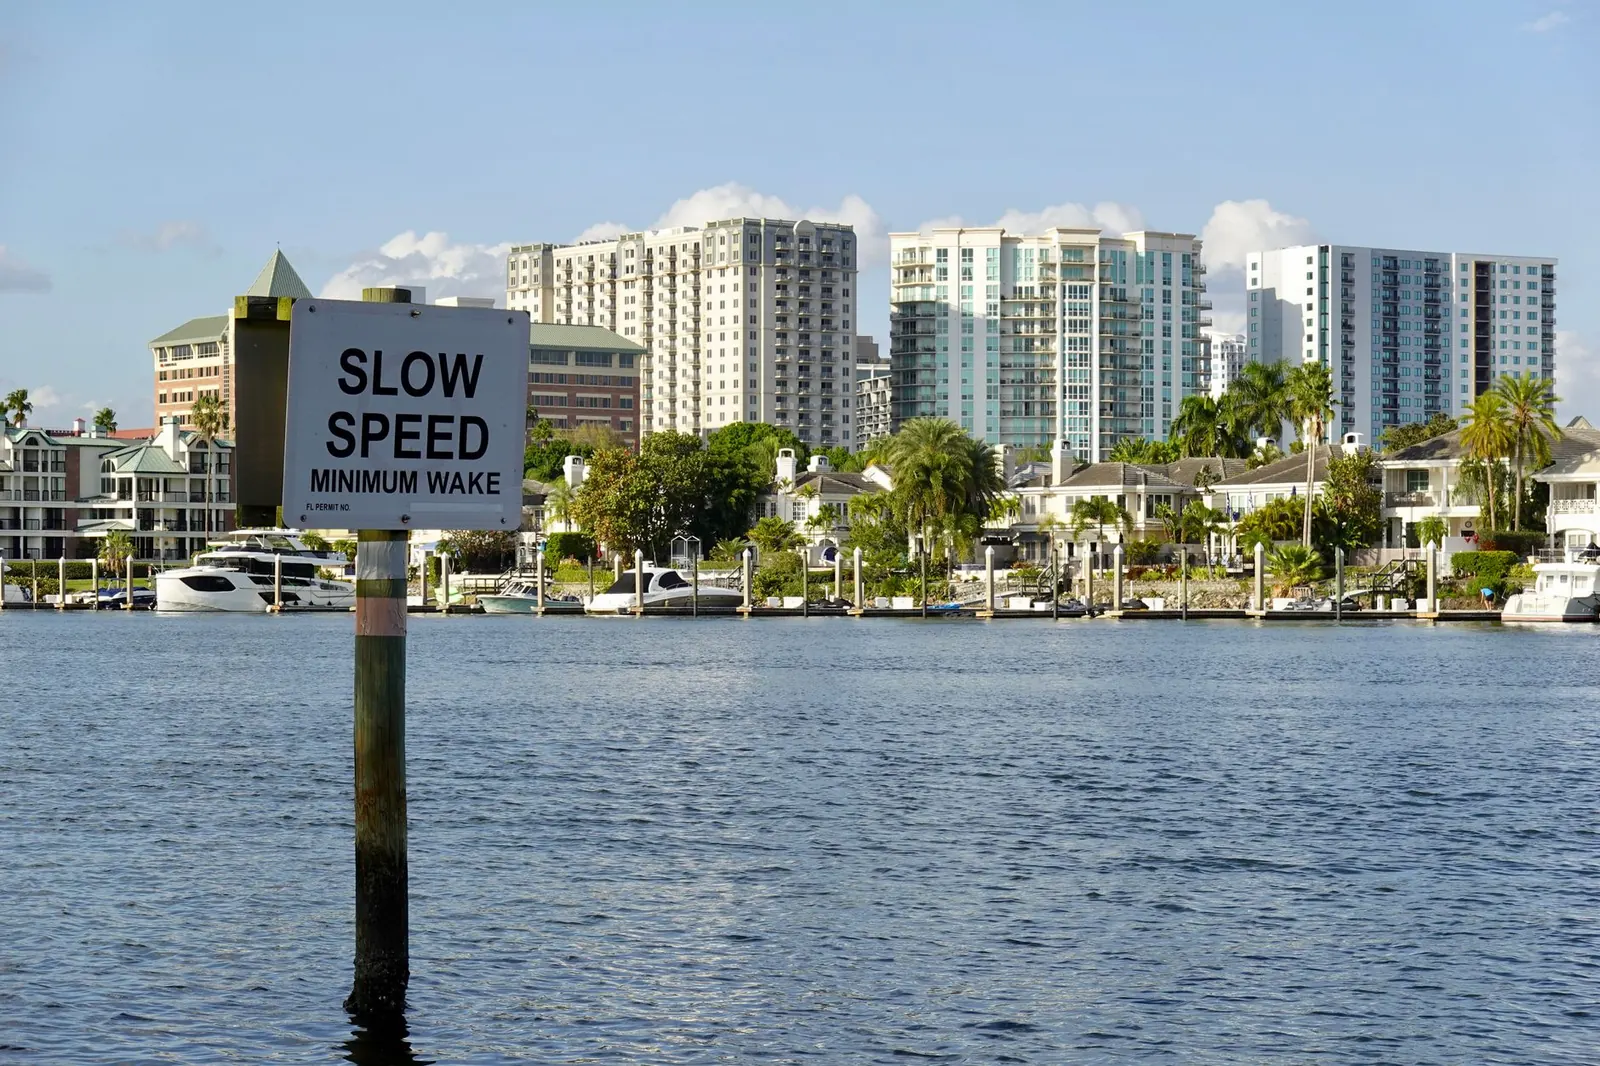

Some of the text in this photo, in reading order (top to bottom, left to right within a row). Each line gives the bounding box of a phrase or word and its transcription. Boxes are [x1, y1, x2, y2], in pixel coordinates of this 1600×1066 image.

[337, 347, 484, 399] SLOW
[325, 410, 489, 460] SPEED
[310, 468, 501, 494] MINIMUM WAKE
[306, 503, 314, 511] FL
[315, 503, 339, 511] PERMIT
